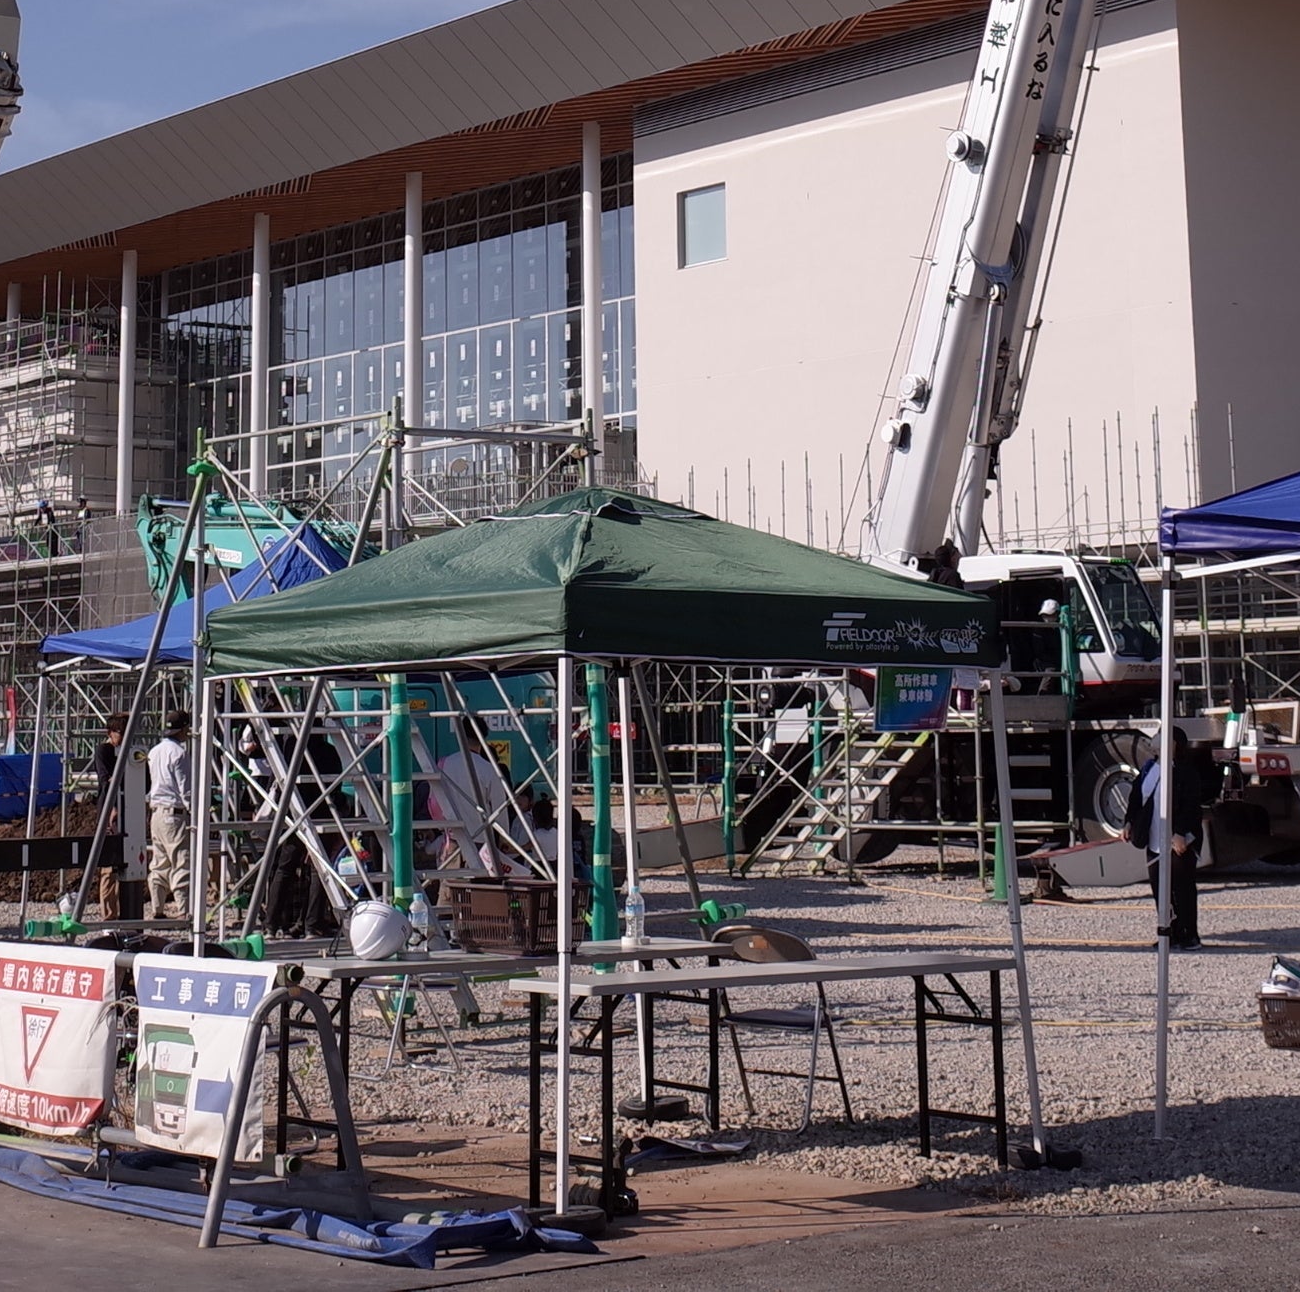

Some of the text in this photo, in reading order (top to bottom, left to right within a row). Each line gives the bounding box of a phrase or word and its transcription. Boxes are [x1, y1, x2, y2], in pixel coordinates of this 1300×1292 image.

[826, 641, 854, 650] Powered
[855, 641, 863, 652] by
[894, 673, 938, 687] 高所作業車
[899, 689, 933, 702] 乗車体験
[2, 963, 93, 997] 場内徐行厳守
[151, 976, 251, 1009] 工事車両
[28, 1017, 47, 1039] 徐行
